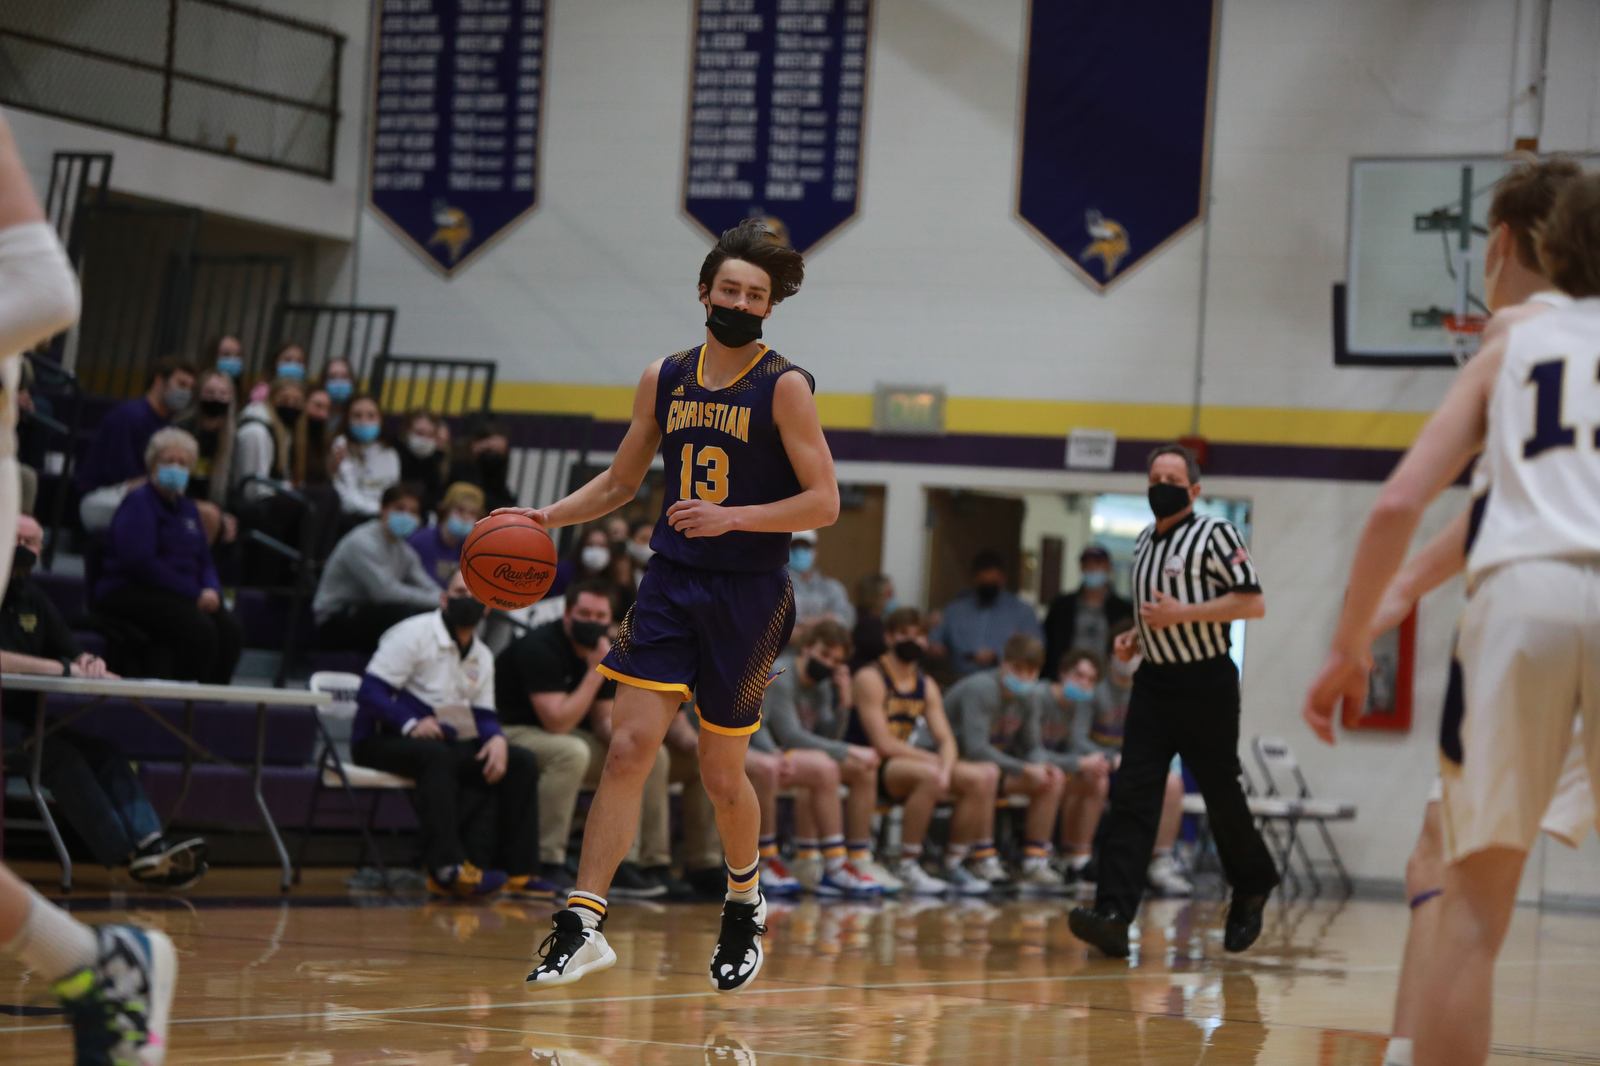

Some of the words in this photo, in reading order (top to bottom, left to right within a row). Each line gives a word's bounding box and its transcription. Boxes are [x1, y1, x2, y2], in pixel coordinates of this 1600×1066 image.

[666, 400, 751, 443] CHRISTIAN
[1520, 356, 1600, 461] 1
[680, 443, 729, 504] 13
[493, 563, 549, 586] Rawlings
